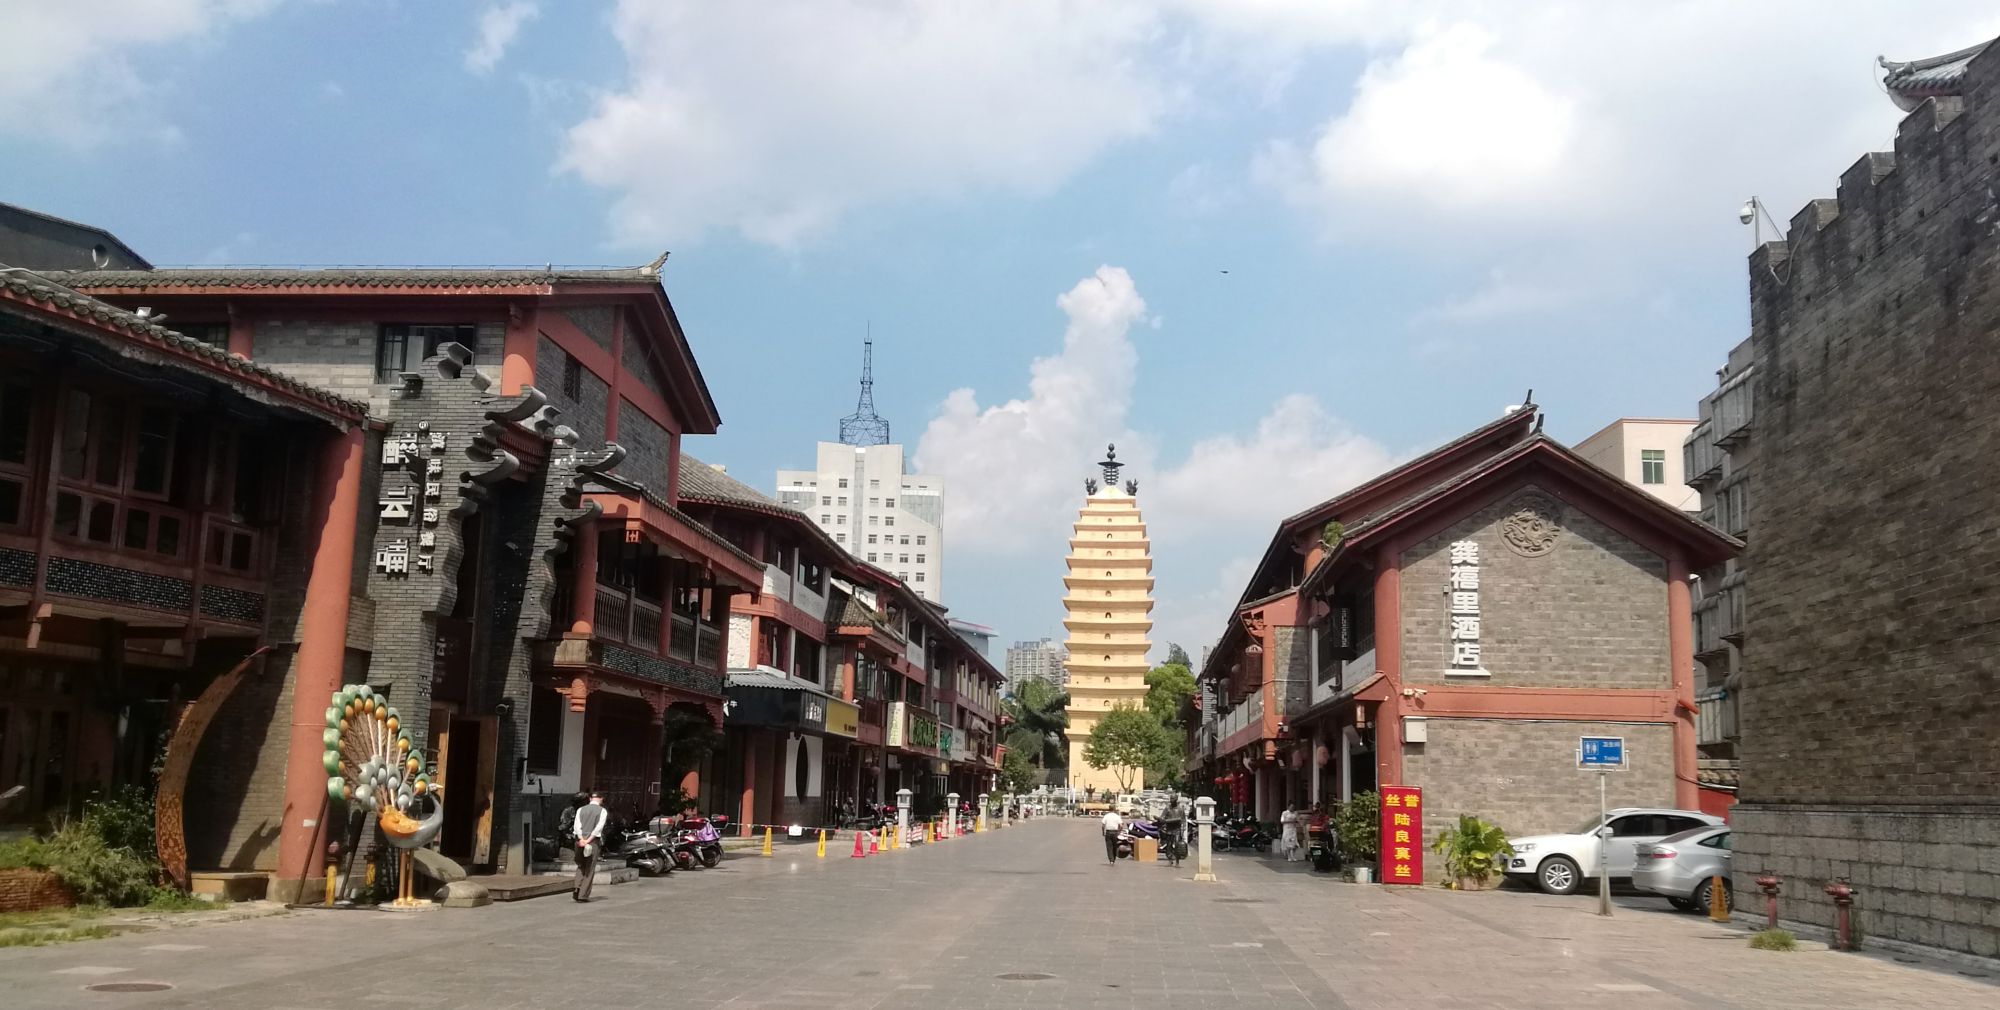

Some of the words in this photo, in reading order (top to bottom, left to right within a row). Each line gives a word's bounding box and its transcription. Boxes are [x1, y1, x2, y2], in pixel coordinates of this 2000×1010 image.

[1450, 541, 1480, 665] 龚禧里酒店
[1394, 813, 1411, 876] 陆良真丝
